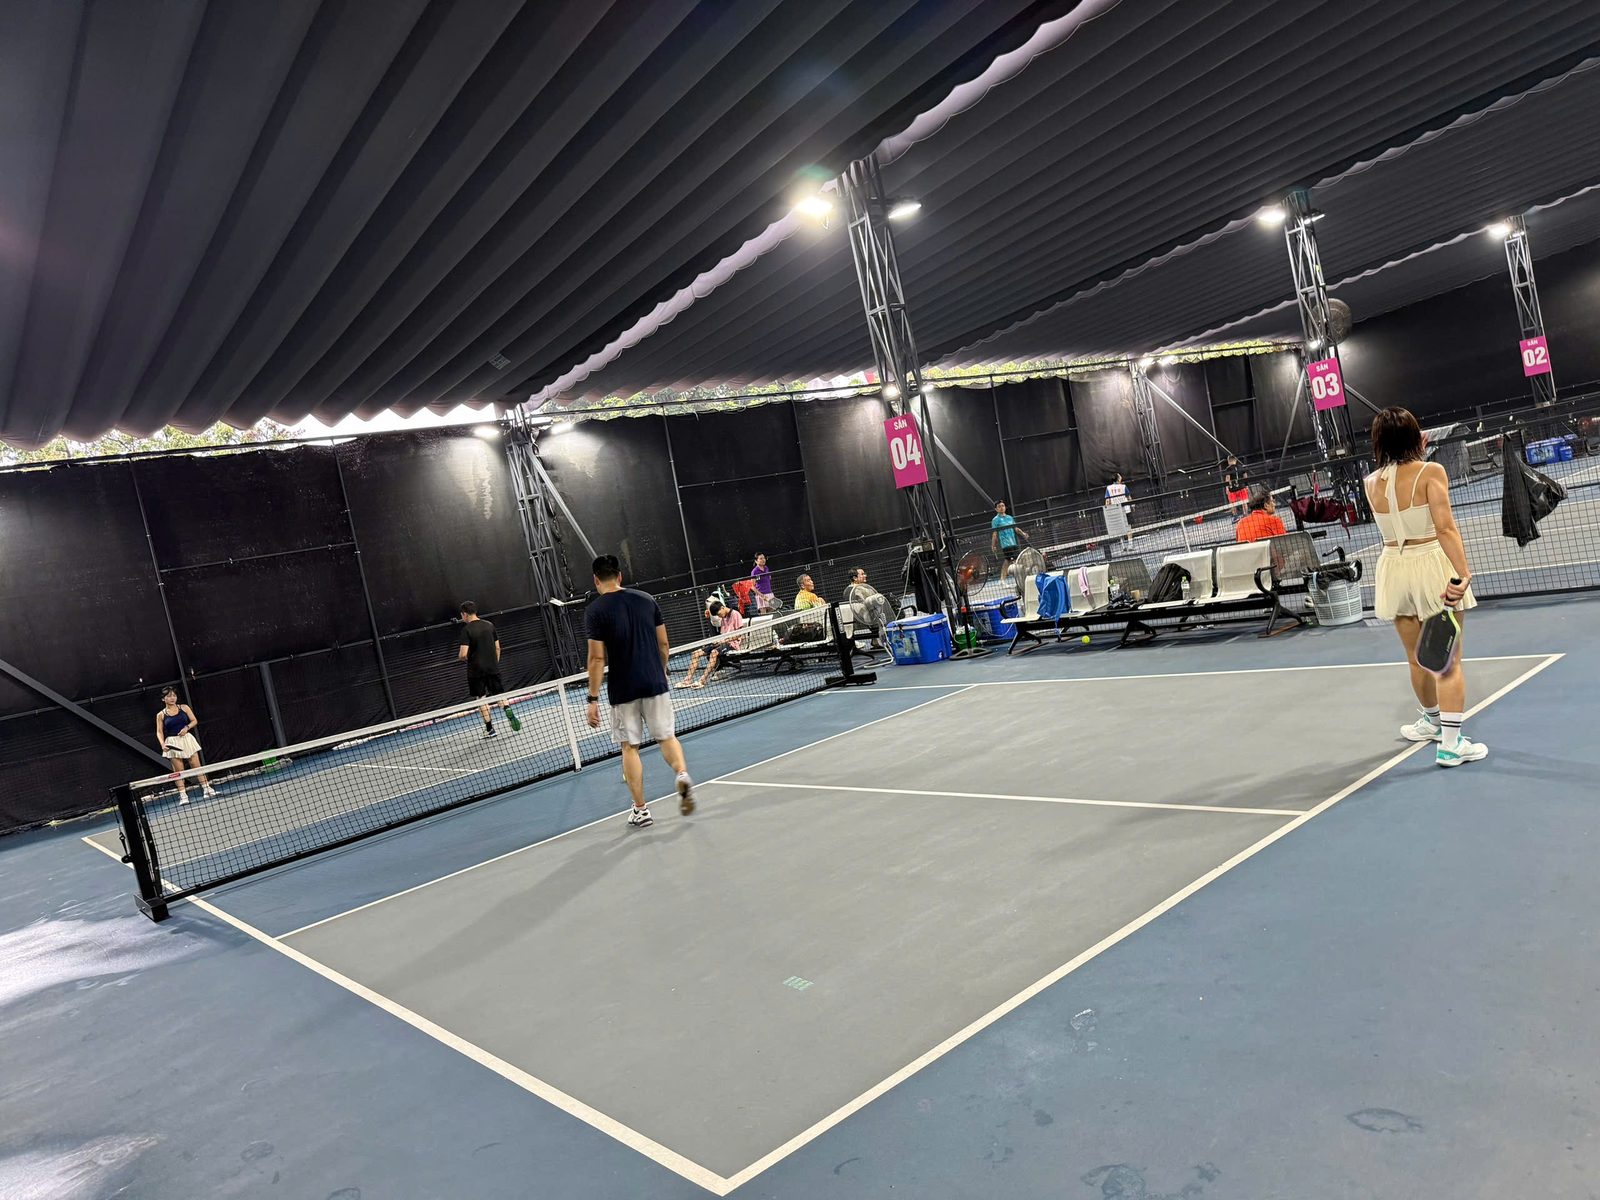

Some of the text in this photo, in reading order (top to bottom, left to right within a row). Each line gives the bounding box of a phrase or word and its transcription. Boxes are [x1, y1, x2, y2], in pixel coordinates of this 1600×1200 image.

[1523, 346, 1548, 367] 02
[1311, 372, 1340, 400] 03
[890, 433, 922, 470] 04
